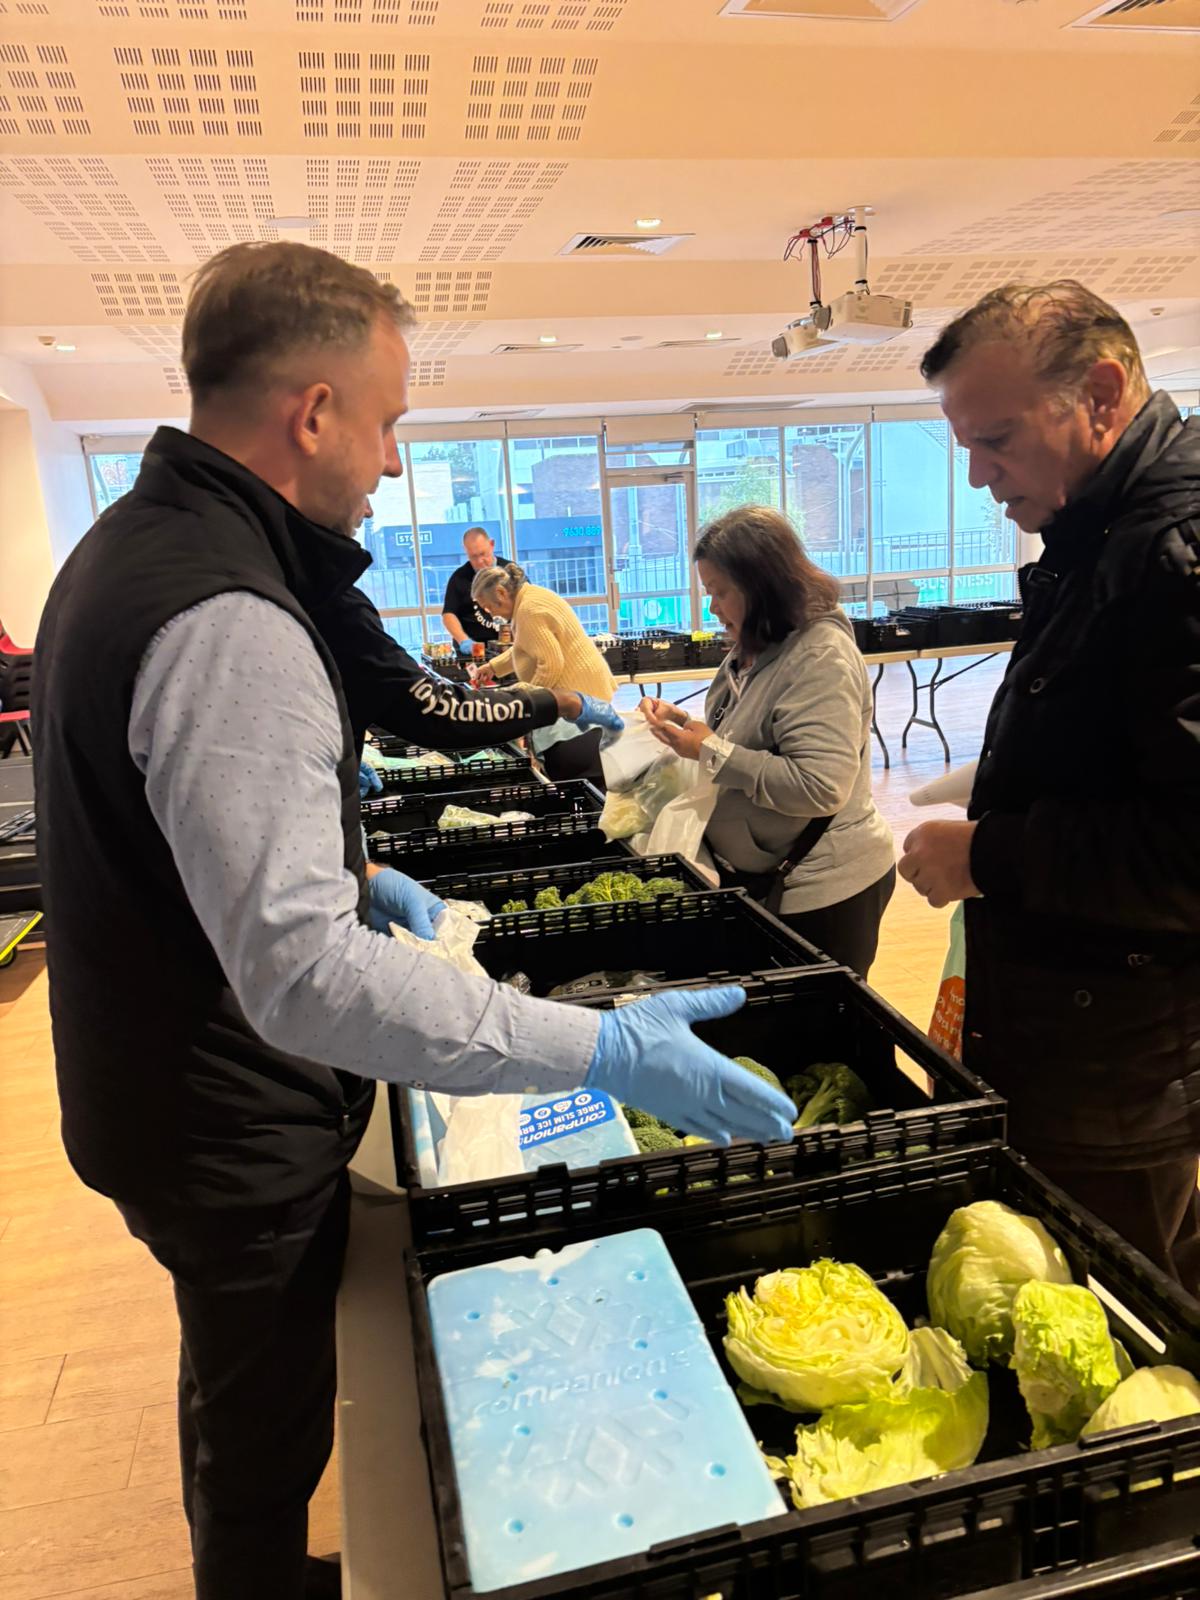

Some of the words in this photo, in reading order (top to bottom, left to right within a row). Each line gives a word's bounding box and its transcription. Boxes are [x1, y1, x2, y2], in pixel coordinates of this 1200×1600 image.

[576, 1101, 605, 1117] LARGE
[553, 1111, 575, 1124] SLIM
[536, 1119, 552, 1130] ICE
